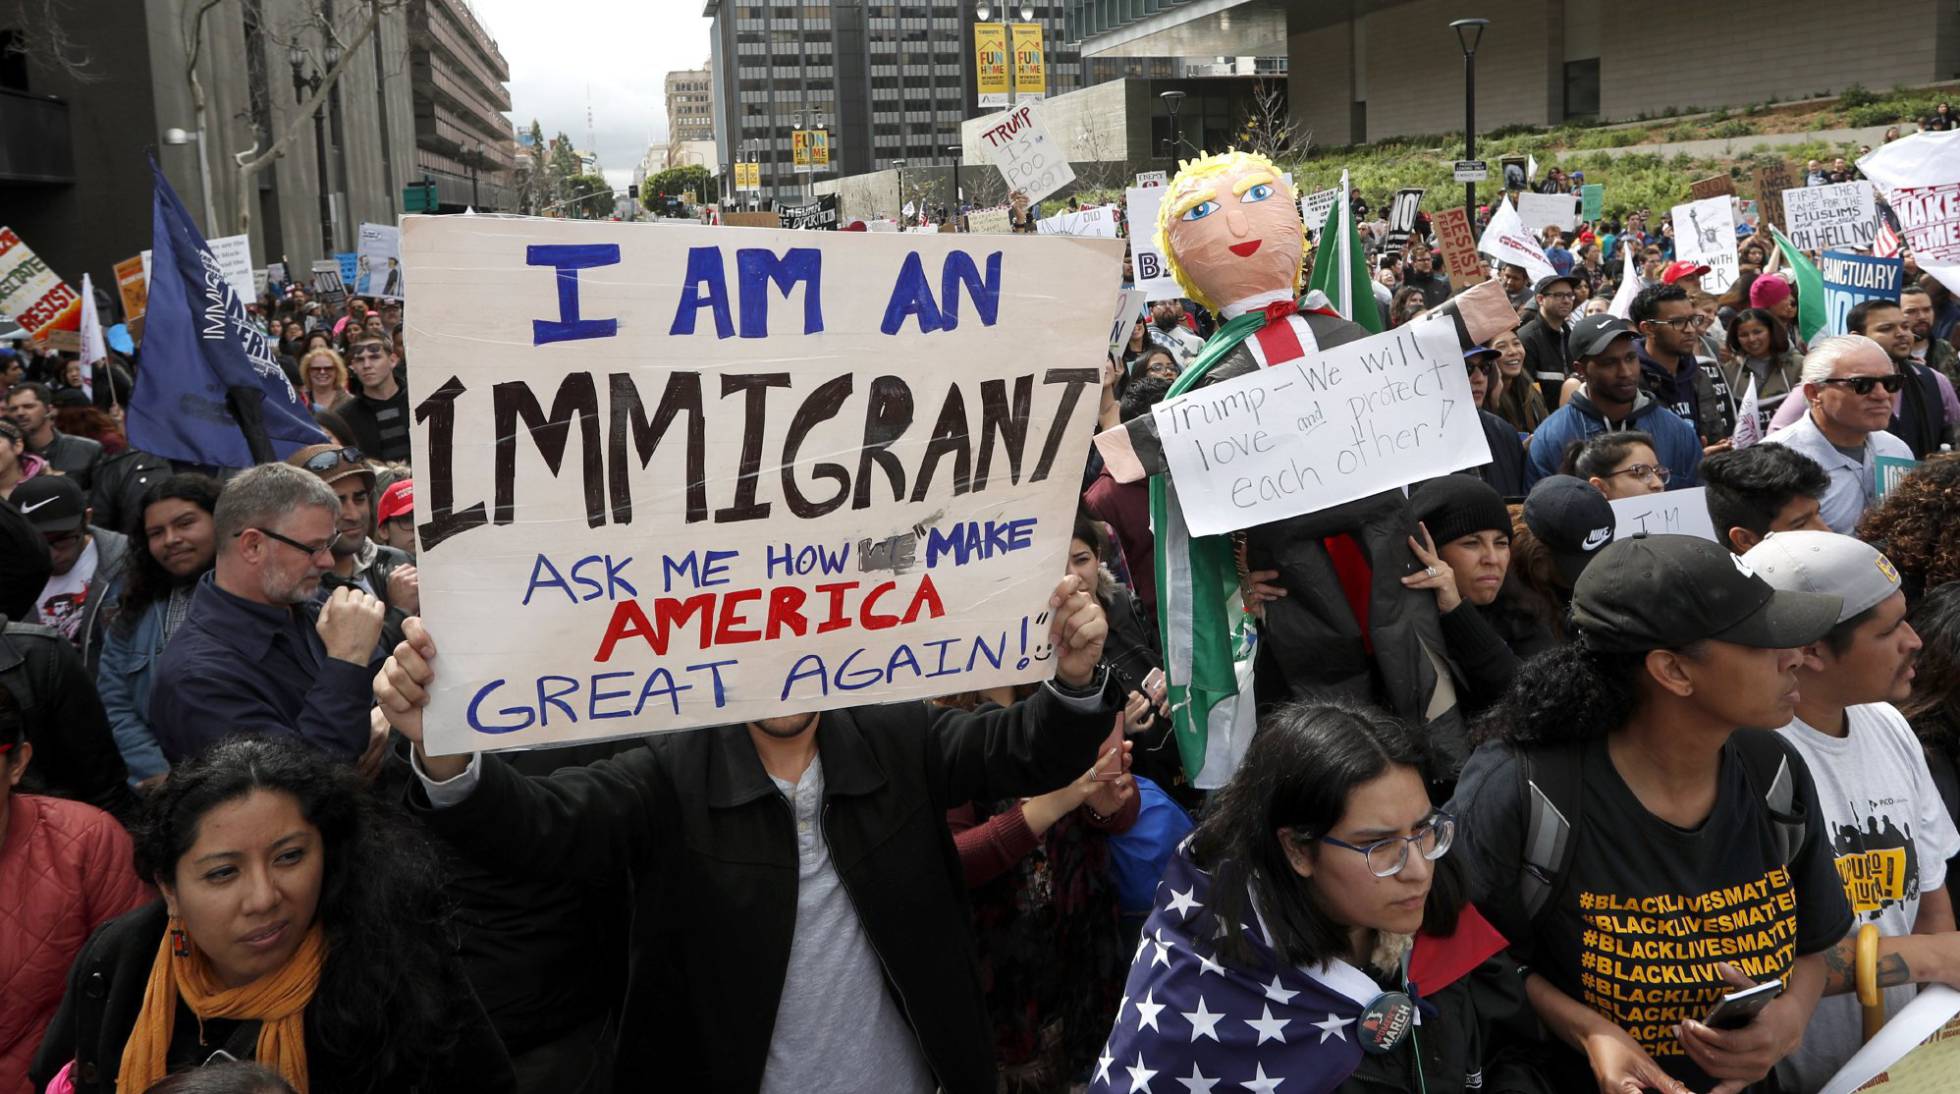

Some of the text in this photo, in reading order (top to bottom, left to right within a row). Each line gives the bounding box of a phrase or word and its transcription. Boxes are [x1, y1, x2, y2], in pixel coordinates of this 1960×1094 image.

[980, 51, 1003, 65] FUN
[1018, 51, 1041, 65] FUN
[794, 133, 825, 147] FUN
[982, 106, 1033, 147] TRUMP
[1002, 134, 1032, 165] IS
[1788, 183, 1861, 203] FIRST THEY
[1823, 199, 1841, 208] FOR
[1844, 196, 1864, 206] THE
[1794, 205, 1861, 223] MUSLIMS
[1437, 213, 1452, 239] FEAR
[1449, 252, 1463, 277] HATE
[1447, 209, 1482, 277] RESIST
[1791, 231, 1810, 249] OH
[1815, 224, 1851, 247] HELL
[1703, 267, 1731, 291] ER
[1707, 254, 1733, 266] WITH
[1823, 257, 1898, 291] SANCTUARY
[16, 281, 76, 334] RESIST
[526, 243, 1004, 346] I AM AN
[1160, 383, 1266, 434] Trump
[1297, 360, 1343, 394] We
[1360, 330, 1425, 375] will
[1195, 360, 1450, 472] love and protect
[416, 367, 1101, 553] IMMIGRANT
[1232, 458, 1324, 509] each
[1588, 526, 1610, 542] NIKE
[1632, 506, 1680, 535] I'M
[522, 553, 639, 607] ASK
[661, 549, 740, 589] ME
[767, 542, 850, 580] HOW
[594, 574, 945, 663] AMERICA
[467, 659, 741, 736] GREAT
[1583, 915, 1797, 960] #BLACKLIVESMATTE
[1379, 1004, 1410, 1050] MARCH
